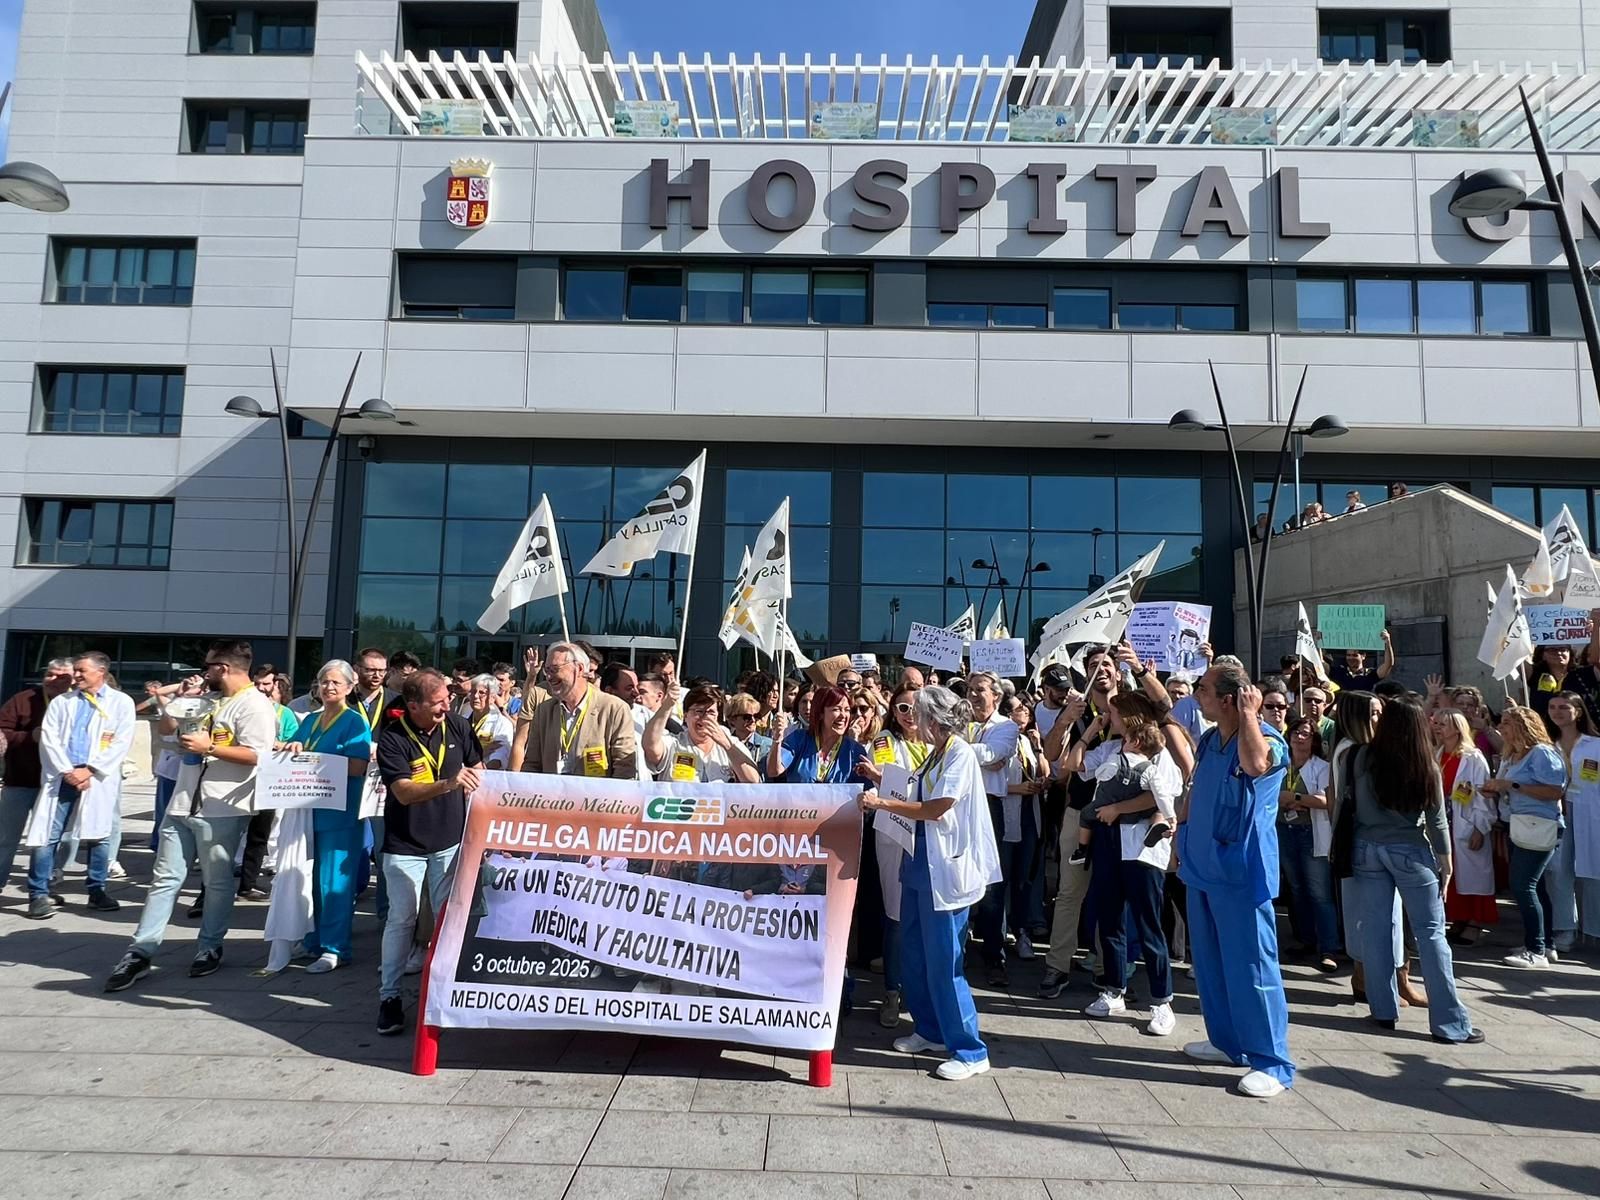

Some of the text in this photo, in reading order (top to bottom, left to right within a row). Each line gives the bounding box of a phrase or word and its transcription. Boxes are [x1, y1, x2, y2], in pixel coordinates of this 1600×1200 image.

[649, 158, 1331, 238] HOSPITAL
[497, 791, 818, 823] Sindicato Médico CESM Salamanca
[486, 819, 828, 859] HUELGA MÉDICA NACIONAL
[523, 868, 550, 894] UN
[553, 870, 640, 913] ESTATUTO
[642, 887, 670, 918] DE
[671, 894, 697, 924] LA
[701, 900, 818, 942] PROFESIÓN
[531, 905, 740, 981] MÉDICA Y FACULTATIVA
[472, 953, 590, 979] 3 octubre 2025
[450, 989, 832, 1029] MEDICO/AS DEL HOSPITAL DE SALAMANCA
